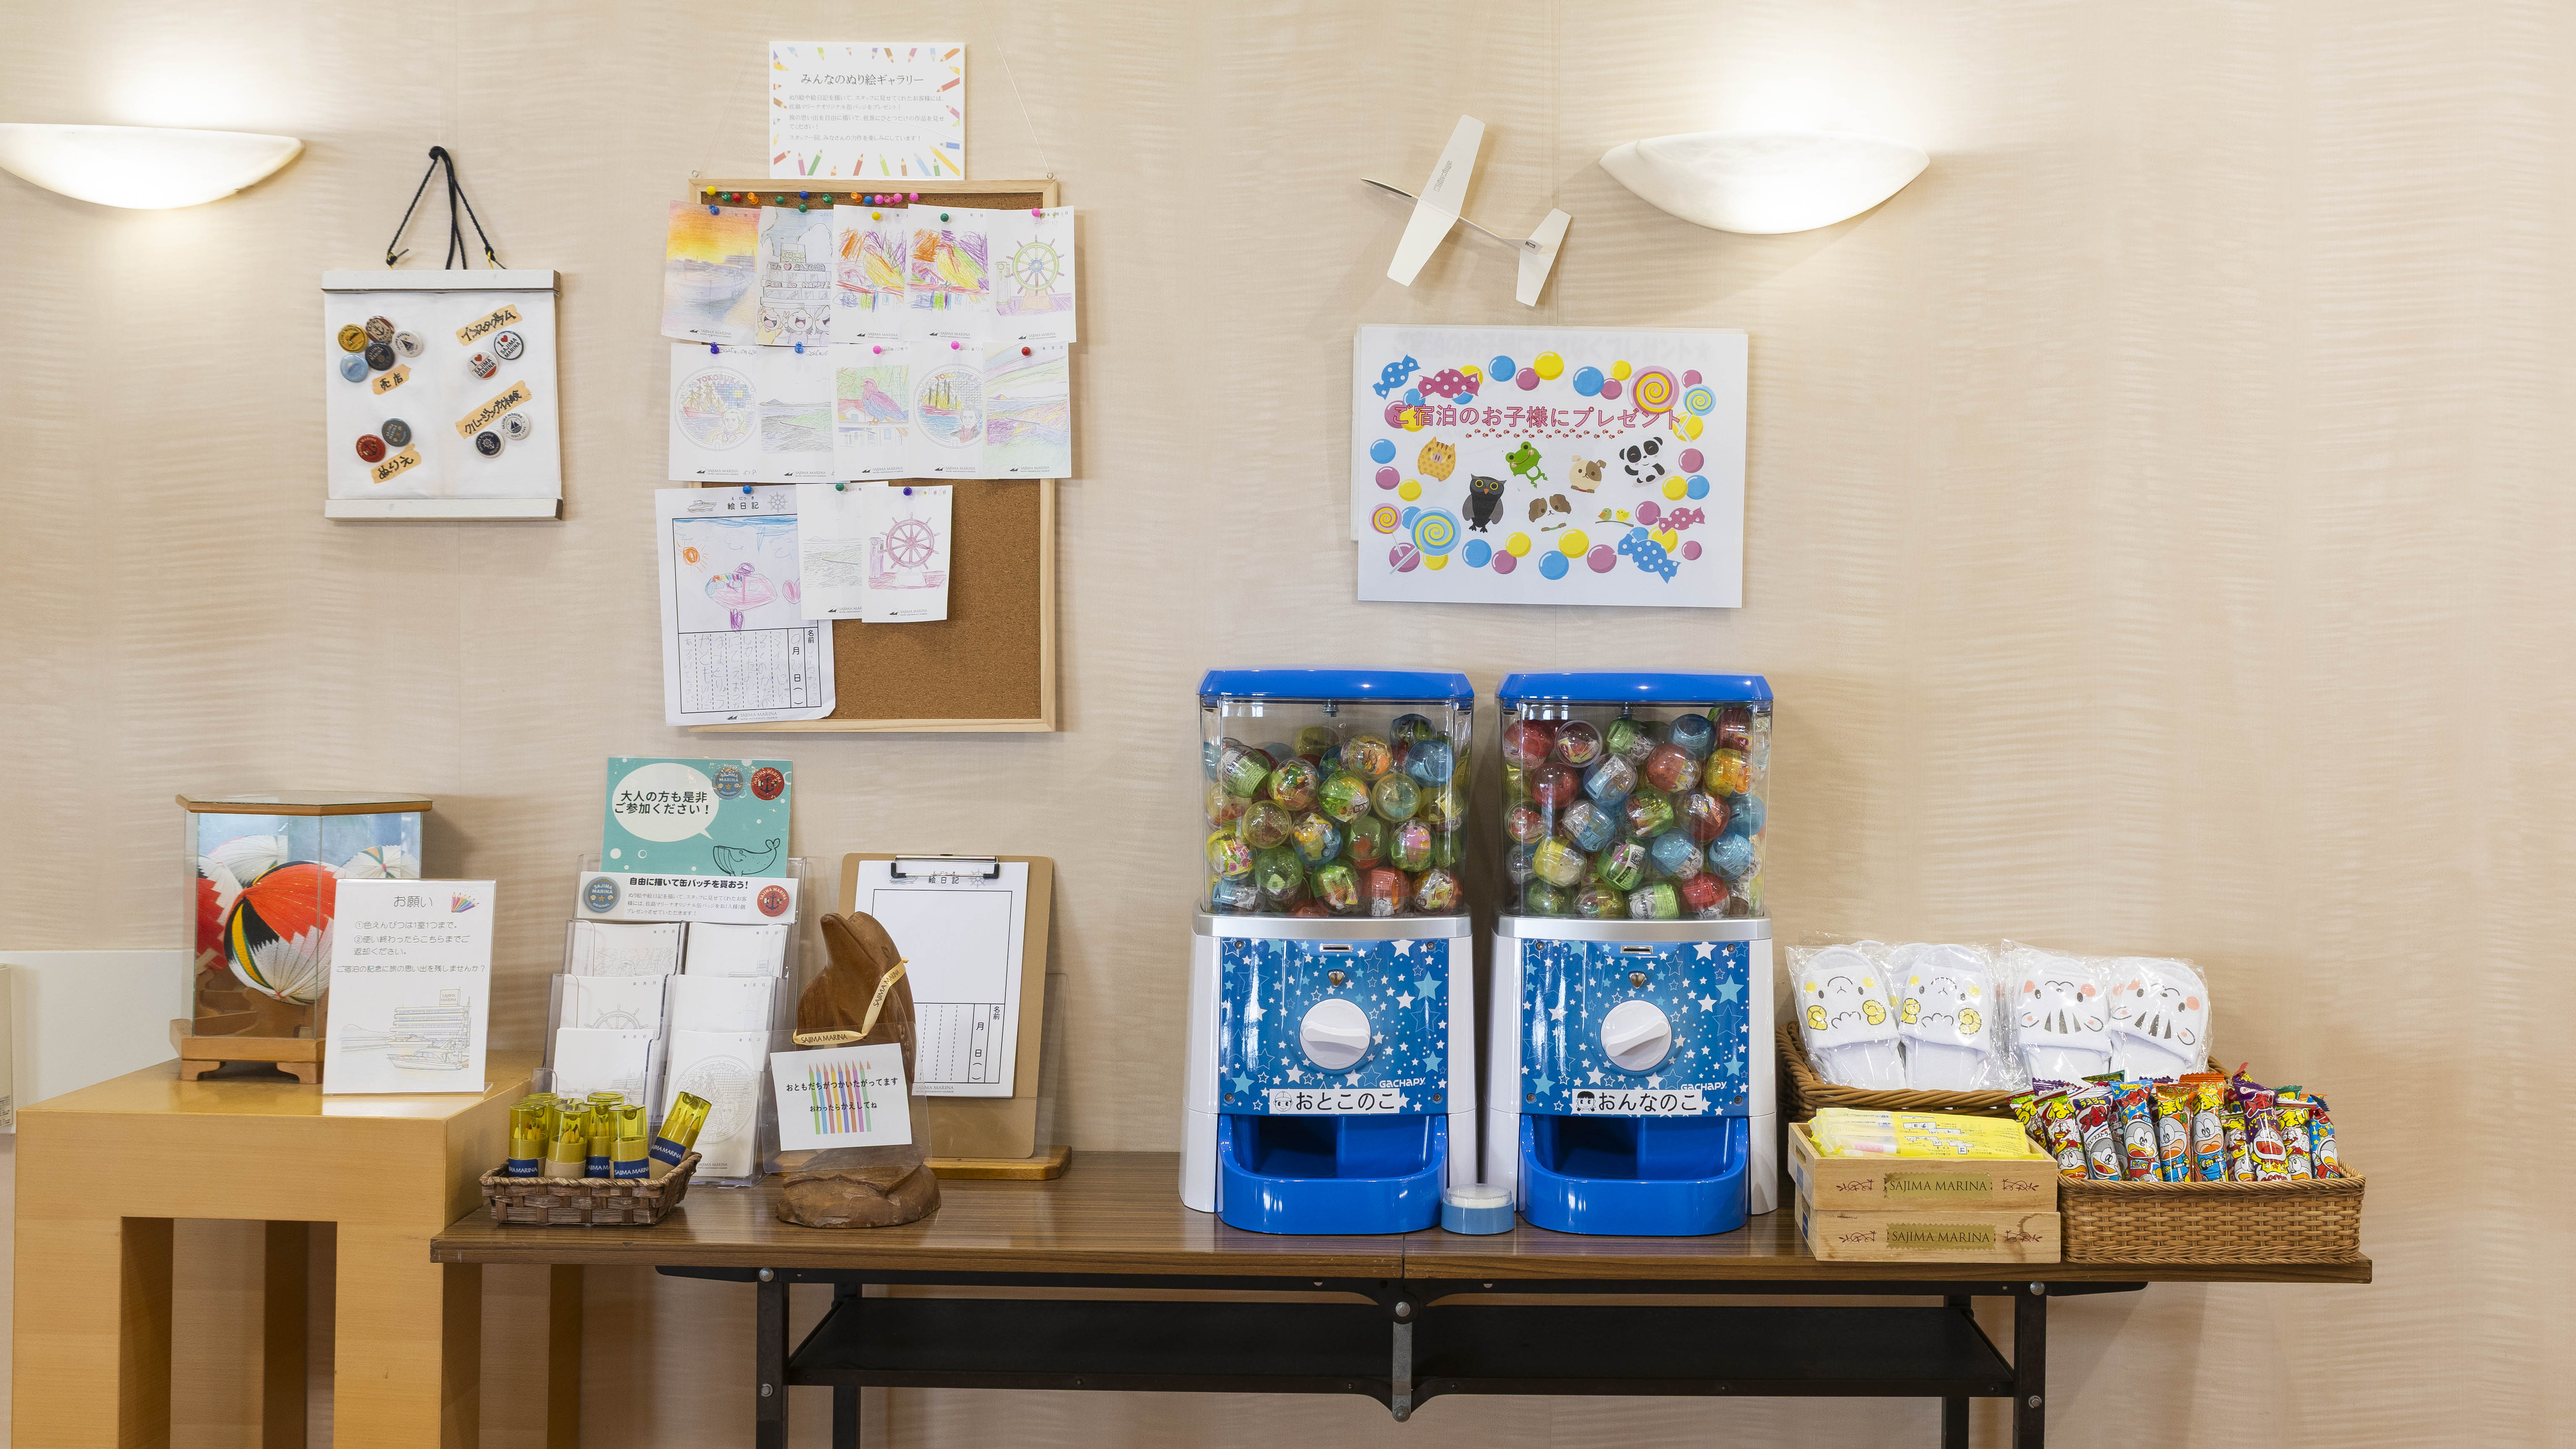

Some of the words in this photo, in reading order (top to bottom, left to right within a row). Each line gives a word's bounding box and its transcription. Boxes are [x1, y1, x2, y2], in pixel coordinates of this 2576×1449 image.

[801, 74, 924, 85] みんなのぬり絵ギャラリー
[461, 310, 517, 341] インスタグラム
[500, 338, 517, 354] SAJIMA
[504, 342, 521, 358] MARINA
[474, 358, 492, 374] SAJIMA
[478, 362, 496, 378] MARINA
[379, 373, 403, 390] 売店
[697, 373, 741, 386] YOKOSUKA
[465, 390, 522, 434] クルージング体験
[1392, 404, 1681, 430] ご宿泊のお子様にプレゼント
[389, 425, 397, 439] MARINA
[378, 456, 414, 479] ぬりえ
[807, 630, 814, 644] 名前
[621, 791, 707, 803] 大人の方も是非
[614, 803, 709, 815] ご参加ください！
[629, 877, 748, 889] 自由に描いて缶バッチを貰おう！
[759, 888, 772, 900] SAJIMA
[773, 888, 787, 900] MARINA
[393, 896, 433, 908] お願い
[355, 921, 457, 930] ①色えんぴつは1室1つまで。
[354, 935, 470, 944] ②使い終わったらこちらまでご
[873, 984, 887, 1007] SAJIMA
[884, 969, 900, 984] MARINA
[993, 1006, 1000, 1021] 名前
[976, 1022, 984, 1031] 月
[786, 1077, 898, 1091] おともだちがつかいたがってます
[1379, 1077, 1425, 1088] GACHAPY
[810, 1101, 877, 1112] おわったらかえしてね
[1296, 1092, 1395, 1110] おとこのこ
[1598, 1093, 1697, 1111] おんなのこ
[662, 1147, 681, 1159] MARINA
[1890, 1180, 1931, 1191] SAJIMA
[1935, 1180, 1987, 1191] MARINA
[1892, 1232, 1934, 1243] SAJIMA
[1938, 1232, 1990, 1243] MARINA
